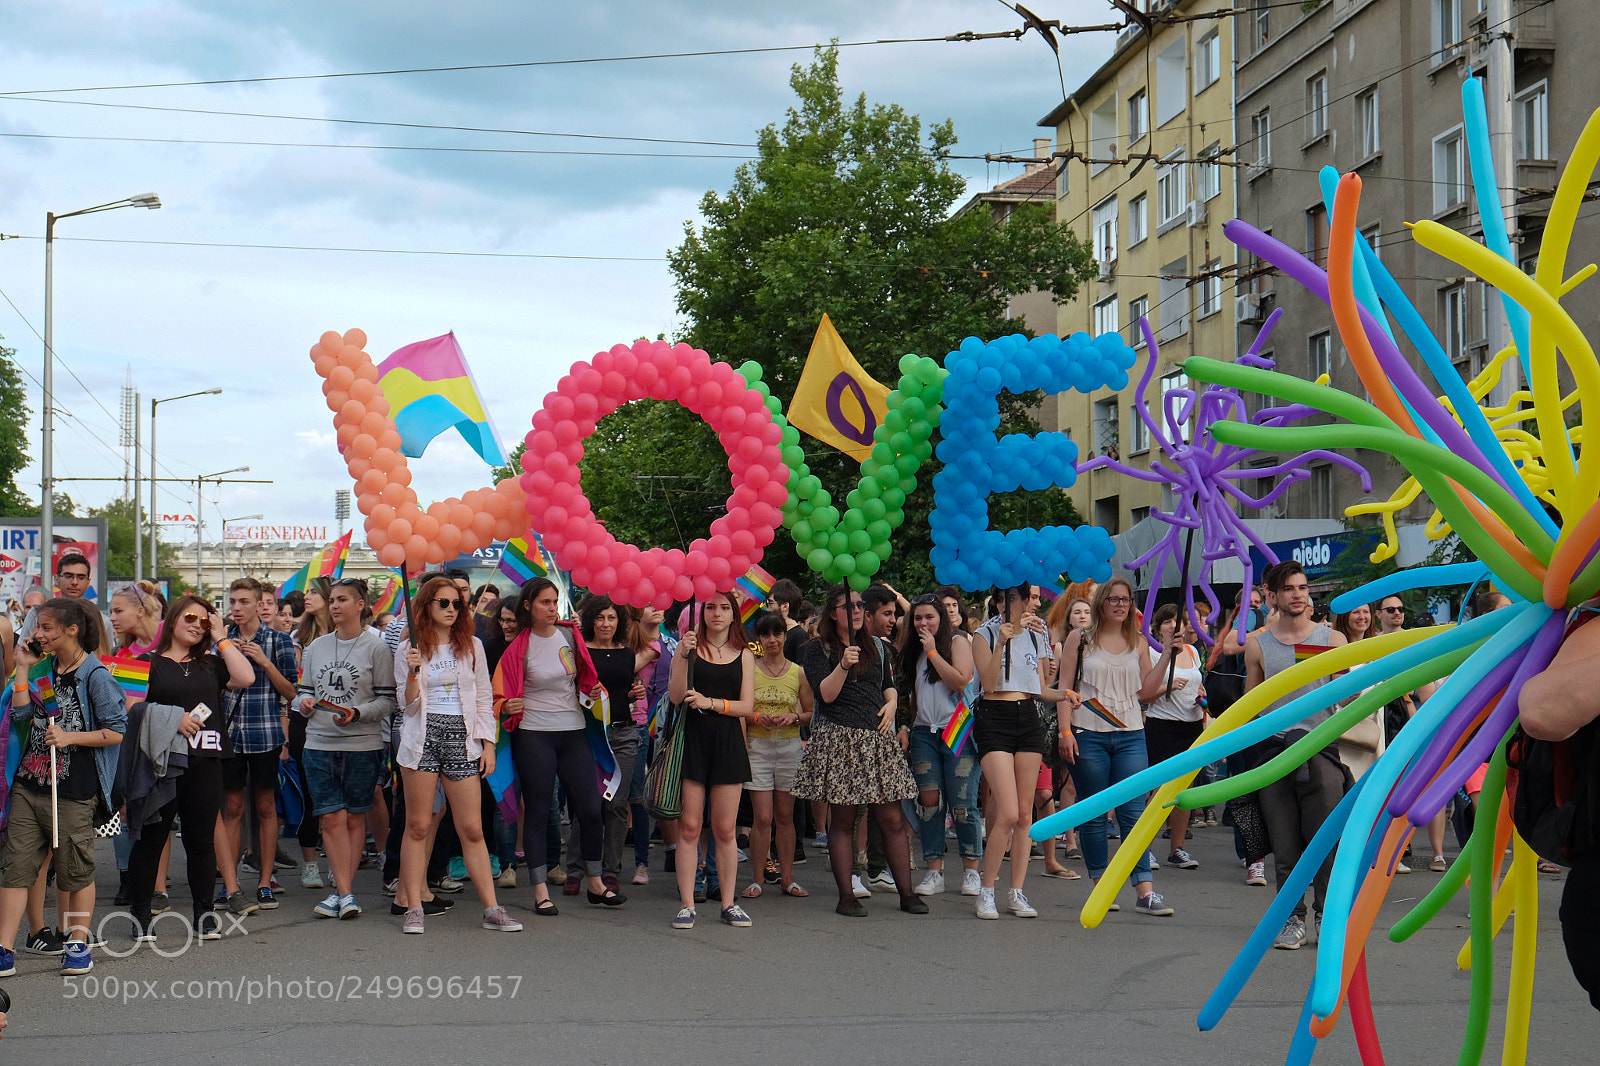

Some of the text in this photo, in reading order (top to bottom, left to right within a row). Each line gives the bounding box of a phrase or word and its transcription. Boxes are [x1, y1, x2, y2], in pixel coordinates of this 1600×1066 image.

[310, 328, 1136, 611] LOVE
[247, 526, 327, 540] GENERALI
[316, 660, 360, 681] CALIFORNIA
[328, 671, 345, 691] LA
